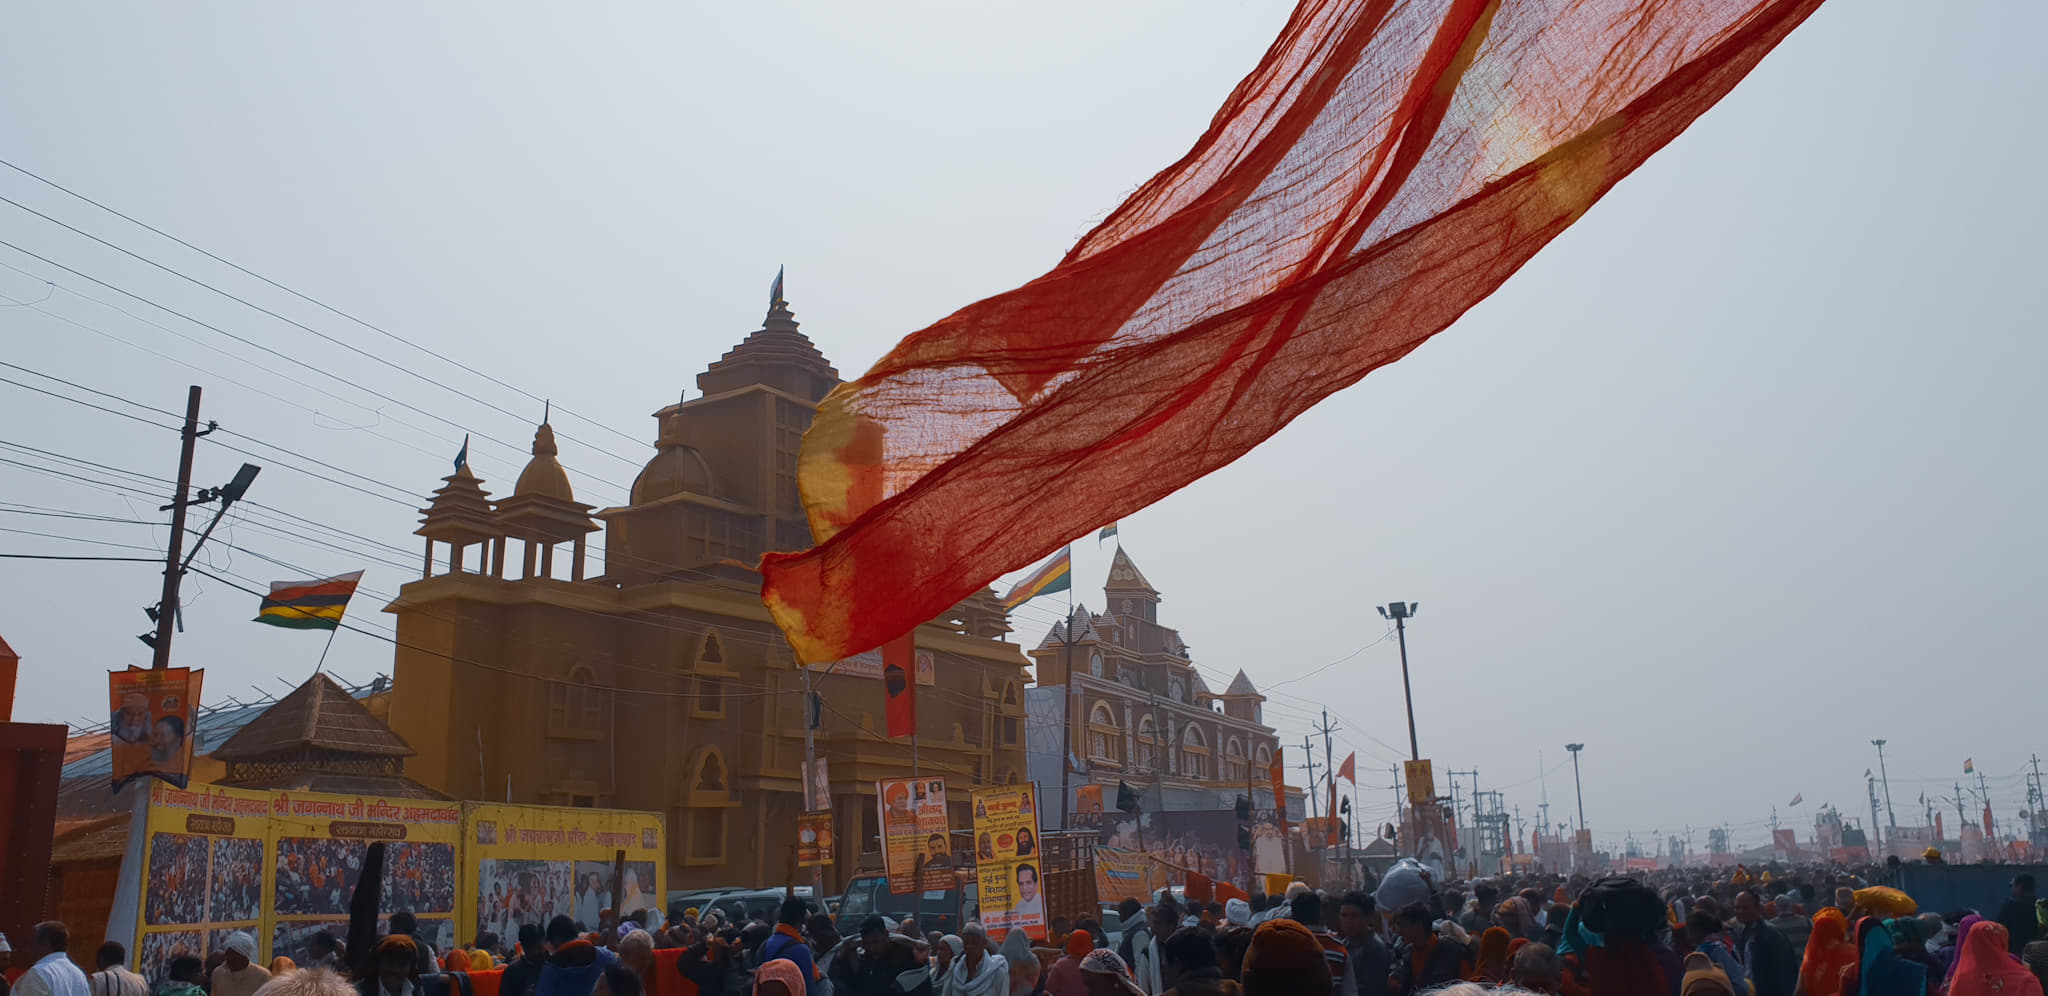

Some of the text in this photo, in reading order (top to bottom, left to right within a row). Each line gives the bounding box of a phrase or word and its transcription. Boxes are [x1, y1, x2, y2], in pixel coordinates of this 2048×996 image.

[273, 792, 289, 814] श्री
[293, 800, 345, 817] जगन्नाथ
[349, 798, 364, 818] जी
